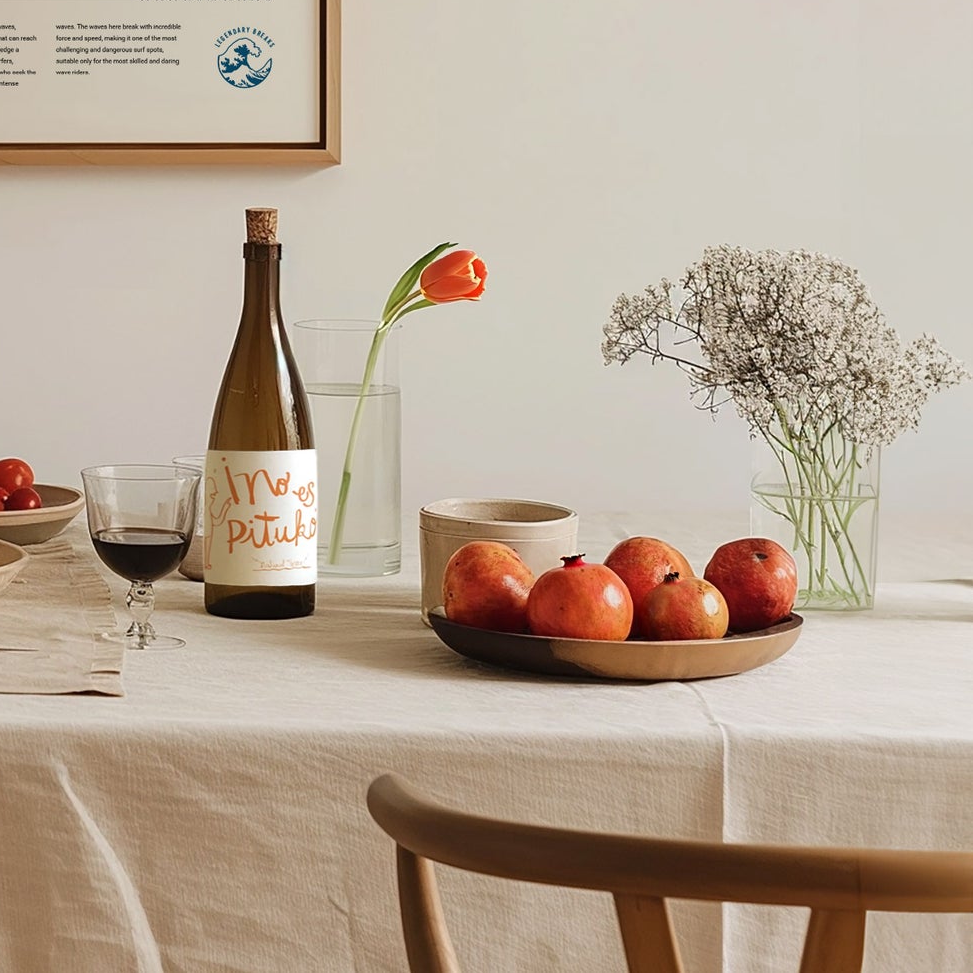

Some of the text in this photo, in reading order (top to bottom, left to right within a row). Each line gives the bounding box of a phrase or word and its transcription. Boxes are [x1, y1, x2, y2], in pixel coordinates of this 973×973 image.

[84, 35, 103, 43] speed,
[104, 35, 125, 43] making
[214, 27, 275, 48] LEGENDARY BREAKS
[56, 46, 89, 54] challenging
[102, 46, 132, 54] dangerous
[146, 46, 164, 54] spots,
[292, 481, 315, 507] es
